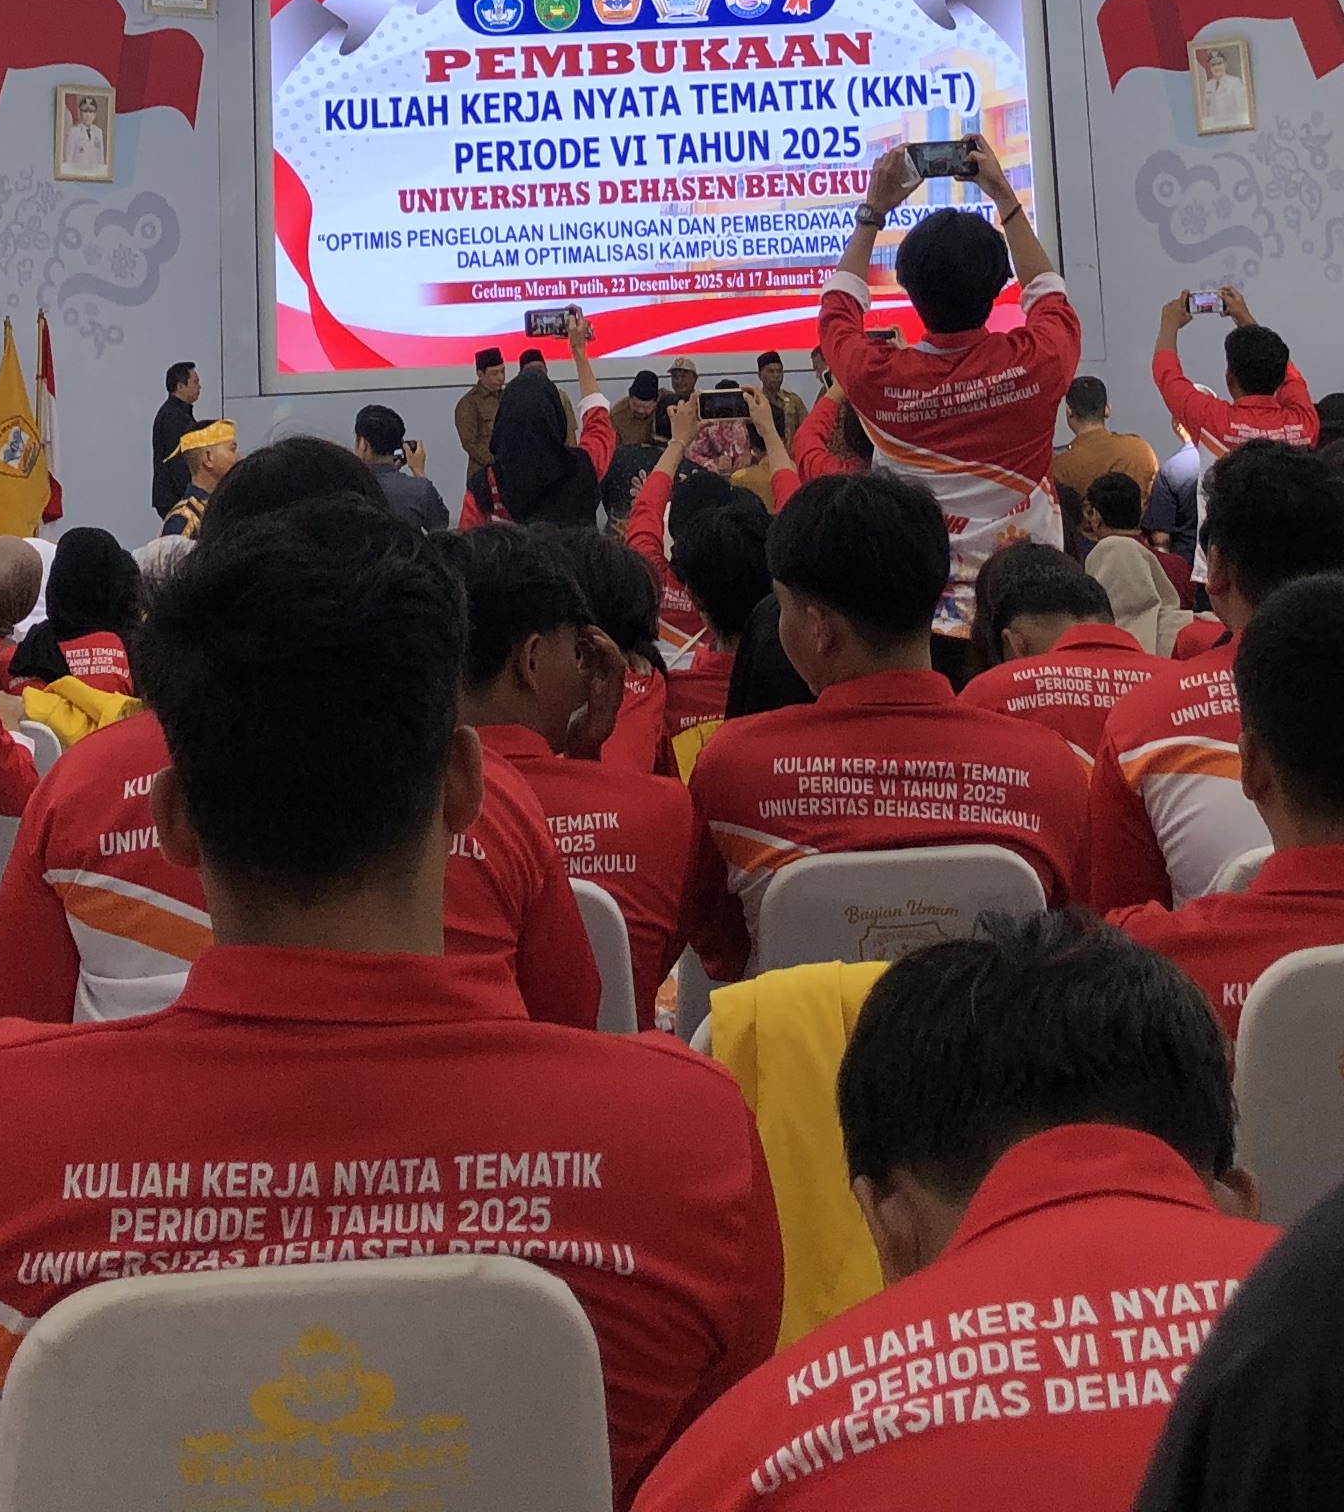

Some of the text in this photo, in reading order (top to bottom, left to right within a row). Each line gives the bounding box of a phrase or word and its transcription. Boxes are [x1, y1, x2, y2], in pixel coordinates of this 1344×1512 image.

[424, 31, 873, 83] PEMBUKAAN
[324, 71, 976, 132] KULIAH KERJA NYATA TEMATIK (KKN-T)
[454, 125, 862, 174] PERIODE VI TAHUN 2025
[398, 169, 873, 214] UNIVERSITAS DEHASEN BENGKU
[407, 223, 544, 248] PENGELOLAAN
[549, 218, 673, 242] LINGKUNGAN
[678, 216, 716, 236] DAN
[721, 209, 856, 235] PEMBERDAYAA
[457, 248, 520, 269] DALAM
[524, 242, 655, 266] OPTIMALISASI
[659, 239, 739, 260] KAMPUS
[471, 282, 523, 301] Gedung
[524, 280, 568, 297] Merah
[570, 278, 609, 296] Putih,
[611, 278, 626, 294] 22
[629, 272, 692, 293] Desember
[693, 273, 723, 290] 2025
[726, 271, 745, 289] s/d
[748, 271, 762, 287] 17
[765, 268, 815, 287] Januari
[884, 386, 920, 399] KULIAH
[954, 378, 985, 394] NYATA
[985, 365, 1027, 386] TEMATIK
[942, 396, 953, 407] VI
[955, 389, 988, 404] TAHUN
[990, 380, 1017, 396] 2025
[875, 382, 1041, 424] UNIVERSITAS DEHASEN BENGKULU
[1012, 666, 1062, 682] KULIAH
[1064, 666, 1108, 681] KERJA
[1035, 677, 1093, 692] PERIODE
[1096, 679, 1109, 694] VI
[1006, 692, 1092, 712] UNIVERSITAS
[1170, 697, 1241, 727] UNIVERS
[772, 756, 1031, 788] KULIAH KERJA NYATA TEMATIK
[798, 776, 1007, 804] PERIODE VI TAHUN 2025
[546, 812, 620, 835] TEMATIK
[758, 796, 1041, 833] UNIVERSITAS DEHASEN BENGKULU
[62, 1151, 603, 1200] KULIAH KERJA NYATA TEMATIK
[108, 1196, 552, 1244] PERIODE VI TAHUN 2025
[786, 1319, 935, 1407] KULIAH
[948, 1294, 1100, 1342] KERJA
[850, 1338, 1042, 1412] PERIODE
[1052, 1332, 1100, 1369] VI
[750, 1379, 1032, 1497] UNIVERSITAS
